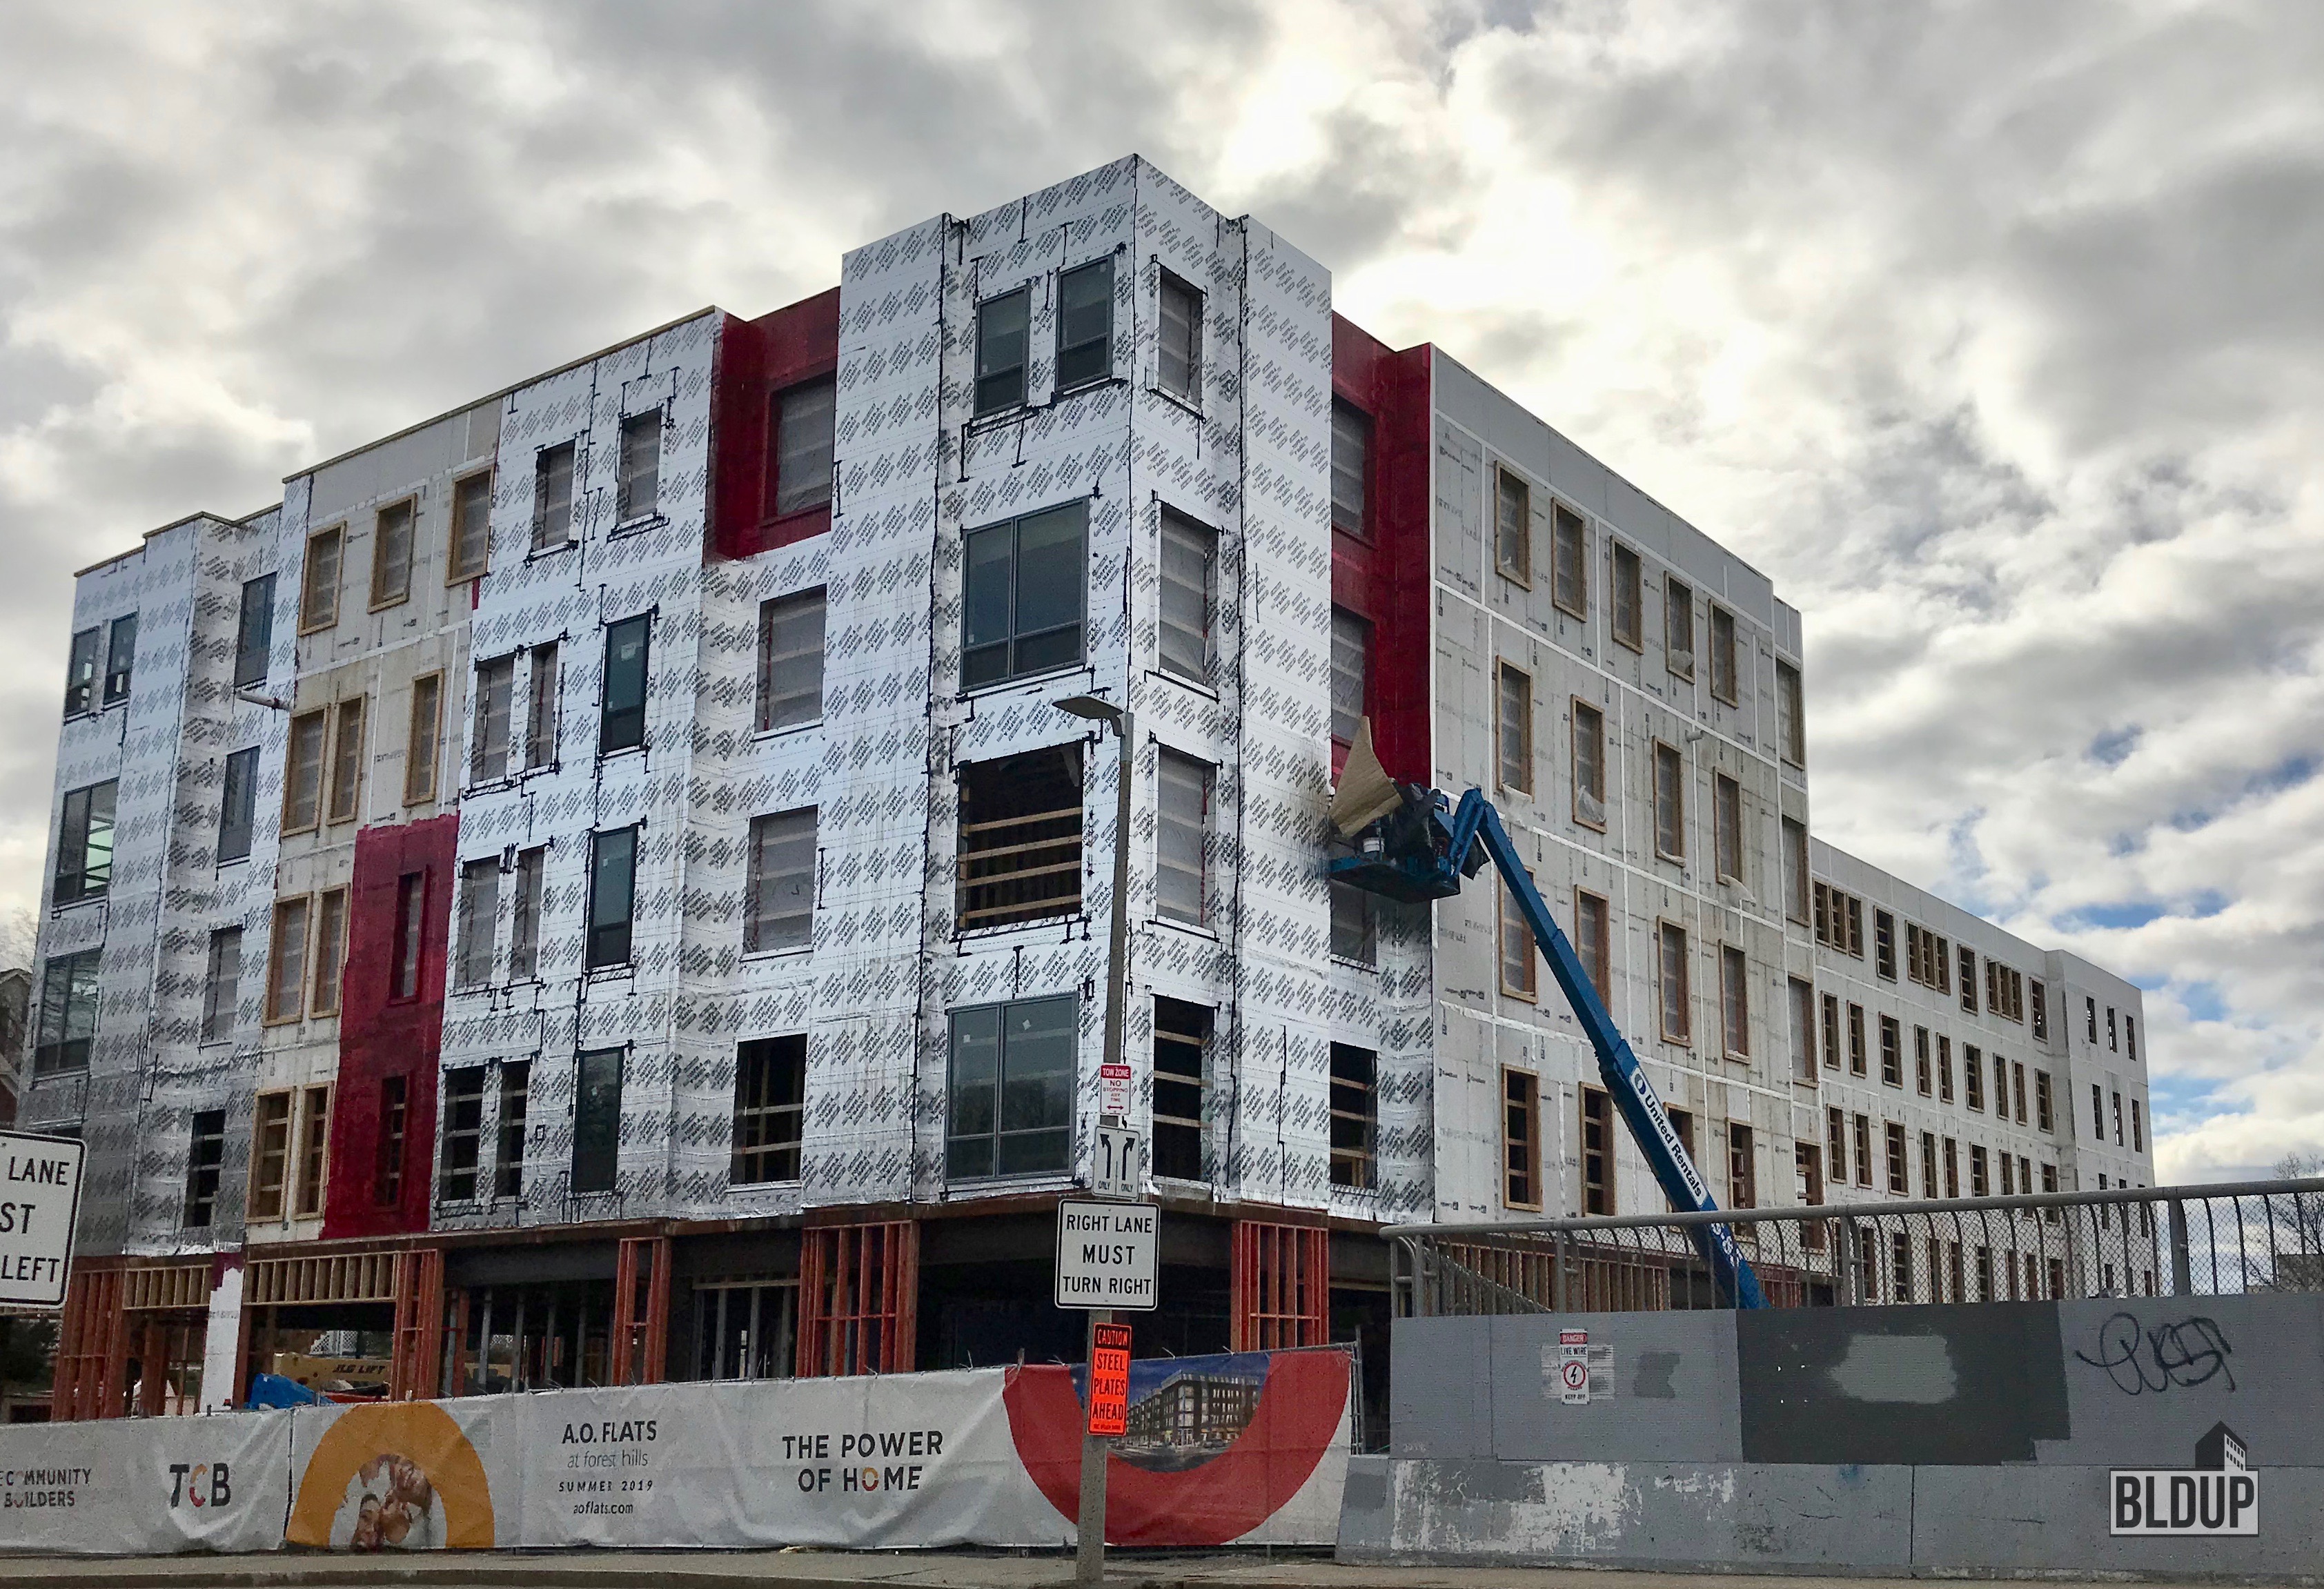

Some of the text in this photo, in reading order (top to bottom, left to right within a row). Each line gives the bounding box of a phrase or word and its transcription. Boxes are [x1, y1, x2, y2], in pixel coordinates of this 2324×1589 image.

[1114, 1069, 1129, 1077] ZONE
[1645, 1094, 1702, 1197] United Rentals
[8, 1156, 70, 1185] LANE
[1066, 1214, 1152, 1234] RIGHT LANE
[1083, 1244, 1135, 1265] MUST
[1, 1255, 60, 1283] LEFT
[1063, 1276, 1152, 1295] TURN RIGHT
[1098, 1329, 1128, 1345] CAUTION
[1562, 1334, 1585, 1343] DANGER
[1561, 1347, 1587, 1356] LIVE WIRE
[1096, 1353, 1125, 1372] STEEL
[1093, 1378, 1125, 1396] PLATES
[1092, 1401, 1124, 1421] AHEAD
[562, 1421, 657, 1444] A.O. FLATS
[782, 1430, 943, 1459] THE POWER
[567, 1448, 649, 1468] at forest hills
[170, 1463, 231, 1510] TCB
[558, 1480, 653, 1492] SUMMER 2019
[798, 1465, 923, 1492] OF HOME
[4, 1490, 75, 1508] BUILDERS
[573, 1501, 633, 1514] aoflats.com
